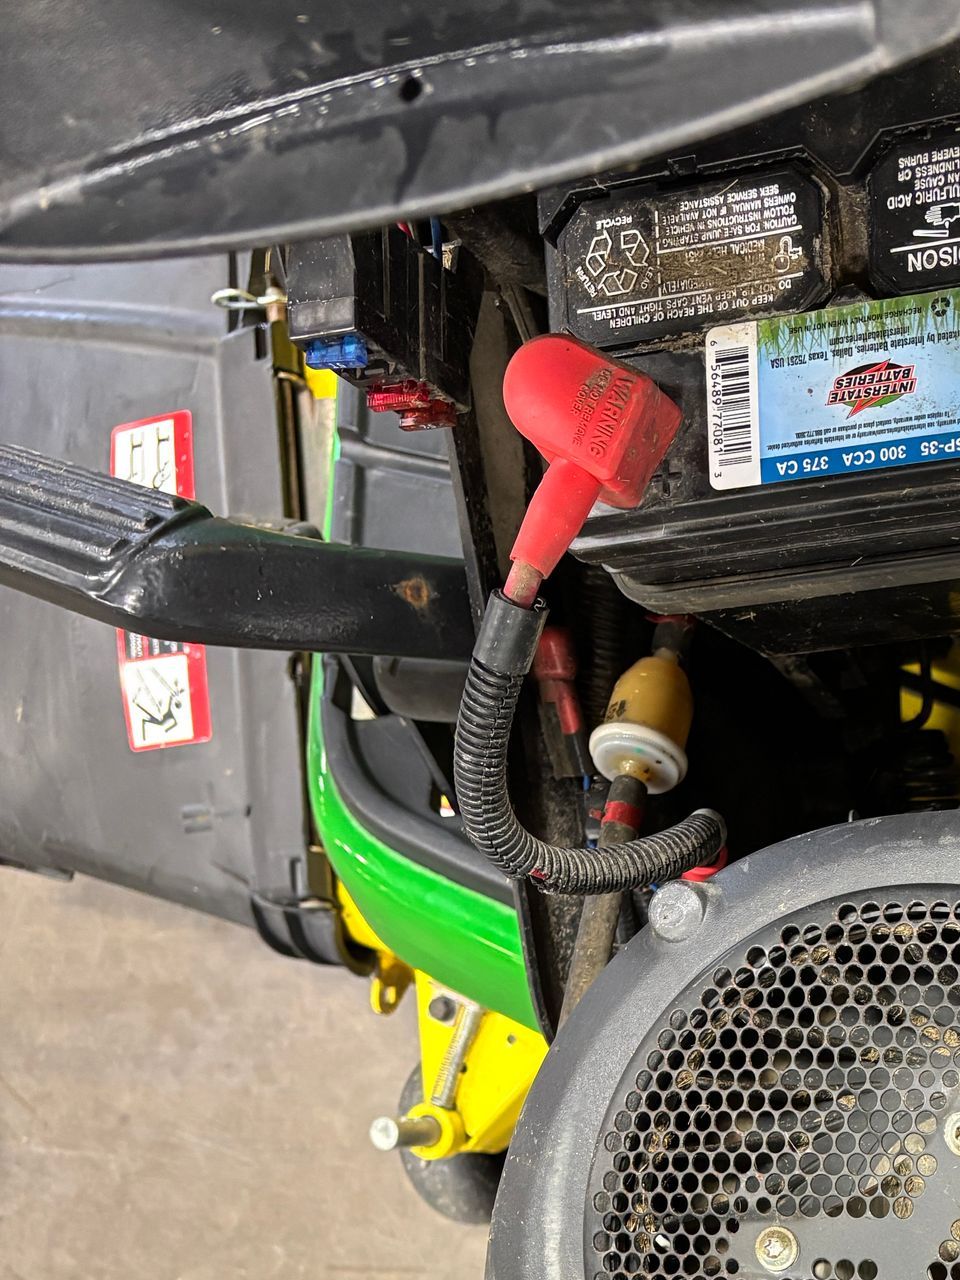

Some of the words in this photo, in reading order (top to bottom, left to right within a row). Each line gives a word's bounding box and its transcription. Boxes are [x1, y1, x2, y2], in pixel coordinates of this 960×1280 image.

[899, 153, 928, 168] BURNS
[898, 170, 911, 181] OR
[914, 174, 944, 190] CAUSE
[727, 188, 757, 202] SERVICE
[760, 184, 779, 196] SEEK
[764, 192, 796, 208] OWNERS
[887, 193, 912, 209] ACID
[702, 209, 717, 218] NOT
[721, 206, 726, 214] IF
[764, 204, 794, 219] FOLLOW
[596, 215, 632, 229] RECYCLE
[663, 212, 698, 225] AVAILABLE
[708, 211, 761, 228] INSTRUCTIONS
[666, 223, 695, 235] VEHICLE
[697, 222, 705, 230] IN
[724, 225, 742, 237] SAFE
[745, 222, 760, 232] FOR
[702, 229, 721, 240] JUMP
[730, 239, 764, 254] MEDICAL
[576, 266, 597, 297] RETURN
[641, 266, 654, 289] LEAD
[779, 279, 791, 289] DO
[691, 294, 712, 305] VENT
[715, 289, 736, 299] KEEP
[752, 294, 773, 305] KEEP
[639, 302, 662, 313] TIGHT
[666, 297, 688, 309] CAPS
[698, 304, 713, 314] THE
[718, 301, 728, 310] OF
[732, 298, 749, 308] OUT
[592, 309, 616, 321] LEVEL
[620, 307, 635, 316] AND
[653, 311, 664, 321] OF
[667, 307, 694, 319] REACH
[885, 307, 921, 319] RECHARGE
[610, 314, 650, 328] CHILDREN
[828, 319, 848, 328] WHEN
[850, 314, 882, 325] MONTHLY
[789, 326, 802, 334] USE
[812, 322, 826, 330] NOT
[830, 326, 909, 346] interstatebatteries.com
[927, 333, 935, 344] by
[891, 336, 924, 350] Interstate
[770, 358, 785, 368] USA
[787, 355, 807, 366] 75251
[809, 352, 828, 362] Texas
[710, 363, 722, 406] 56489
[836, 368, 911, 390] BATTERIES
[829, 381, 914, 403] INTERSTATE
[570, 384, 589, 416] COVER
[590, 378, 634, 458] WARNING
[572, 405, 593, 447] REMOVE
[712, 413, 723, 453] 77081
[842, 450, 875, 466] CCA
[880, 445, 906, 461] 300
[776, 460, 798, 475] CA
[803, 456, 828, 472] 375
